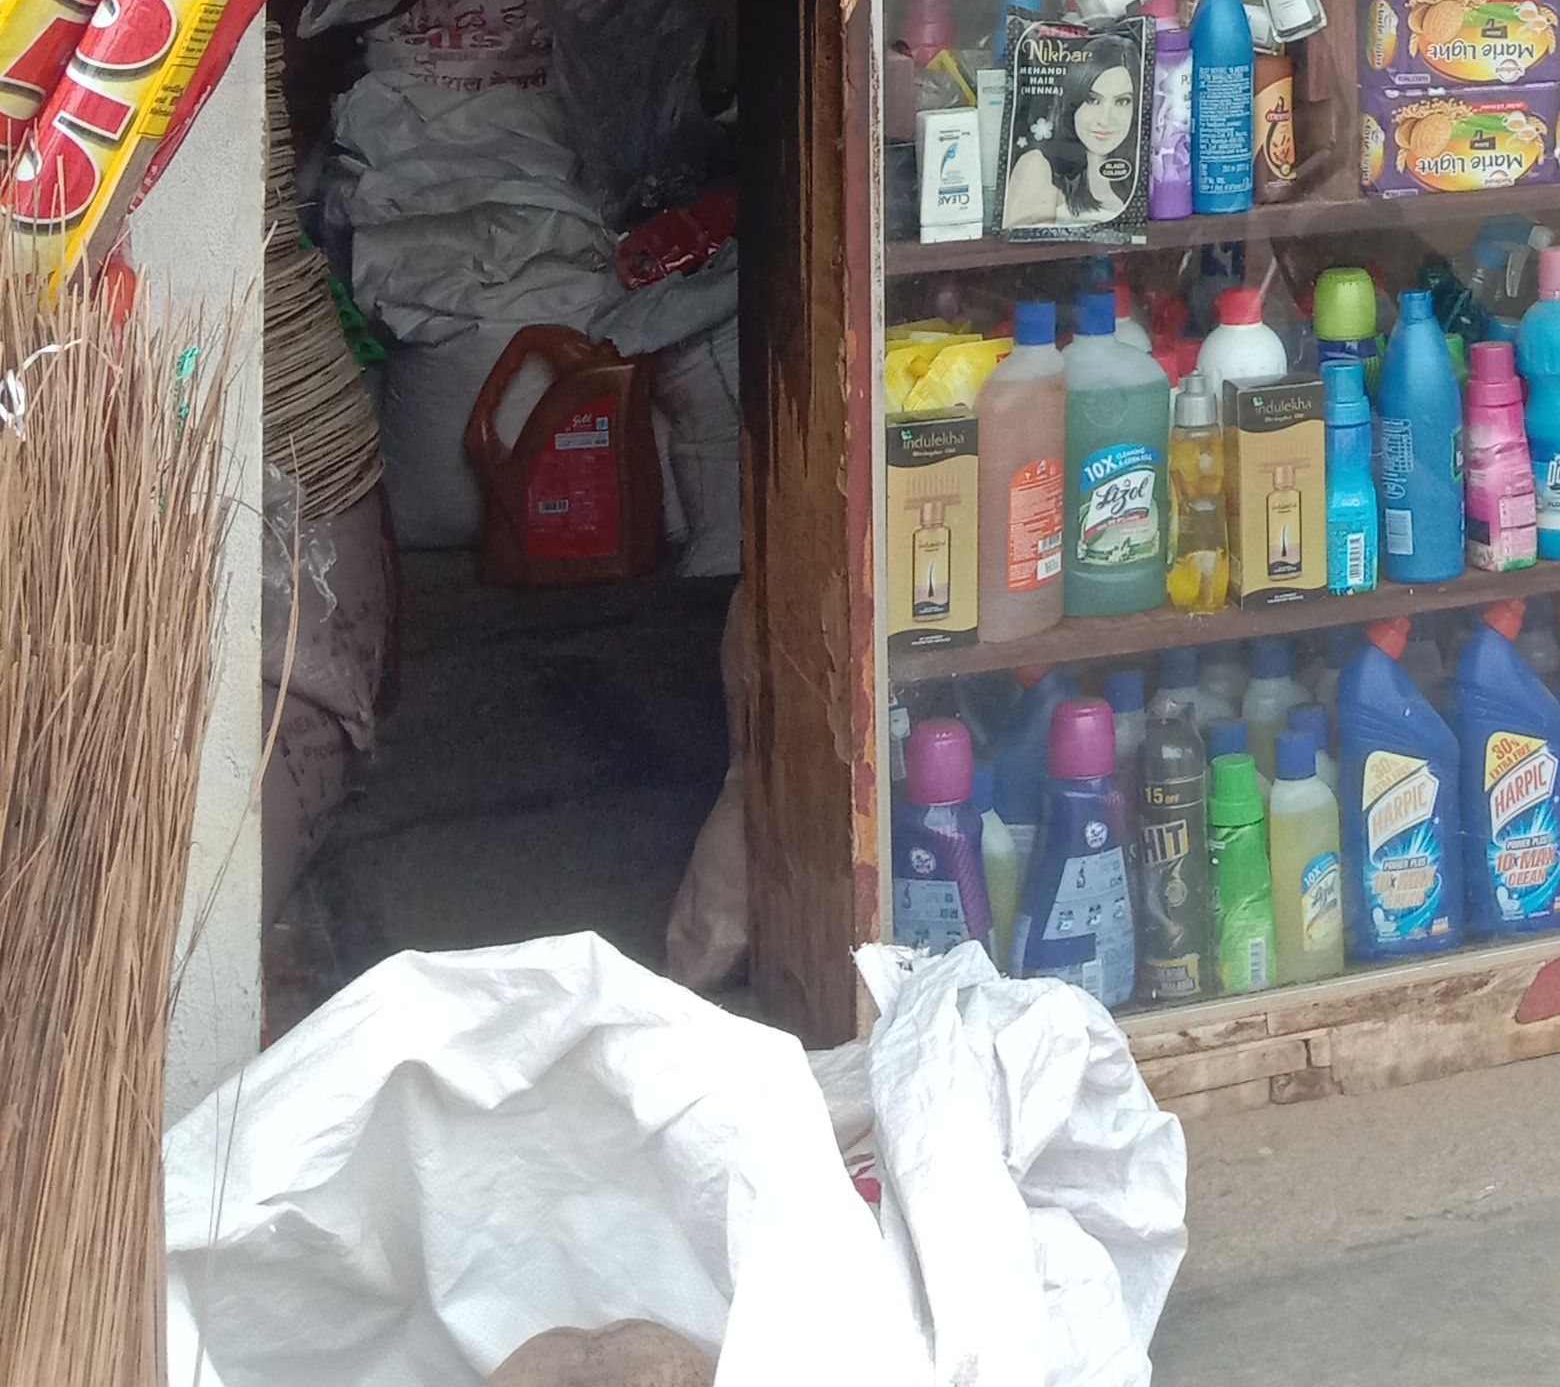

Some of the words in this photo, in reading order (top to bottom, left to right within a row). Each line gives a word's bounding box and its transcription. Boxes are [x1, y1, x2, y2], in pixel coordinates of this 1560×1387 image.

[1022, 39, 1094, 64] Nikhar
[1428, 42, 1474, 62] Light
[1479, 42, 1535, 59] Marie
[1029, 76, 1056, 86] HAIR
[1416, 156, 1464, 175] Light
[1469, 153, 1524, 171] Marie
[1096, 484, 1148, 516] Lizol
[1494, 770, 1549, 820] HARPIC
[1141, 818, 1189, 864] HIT
